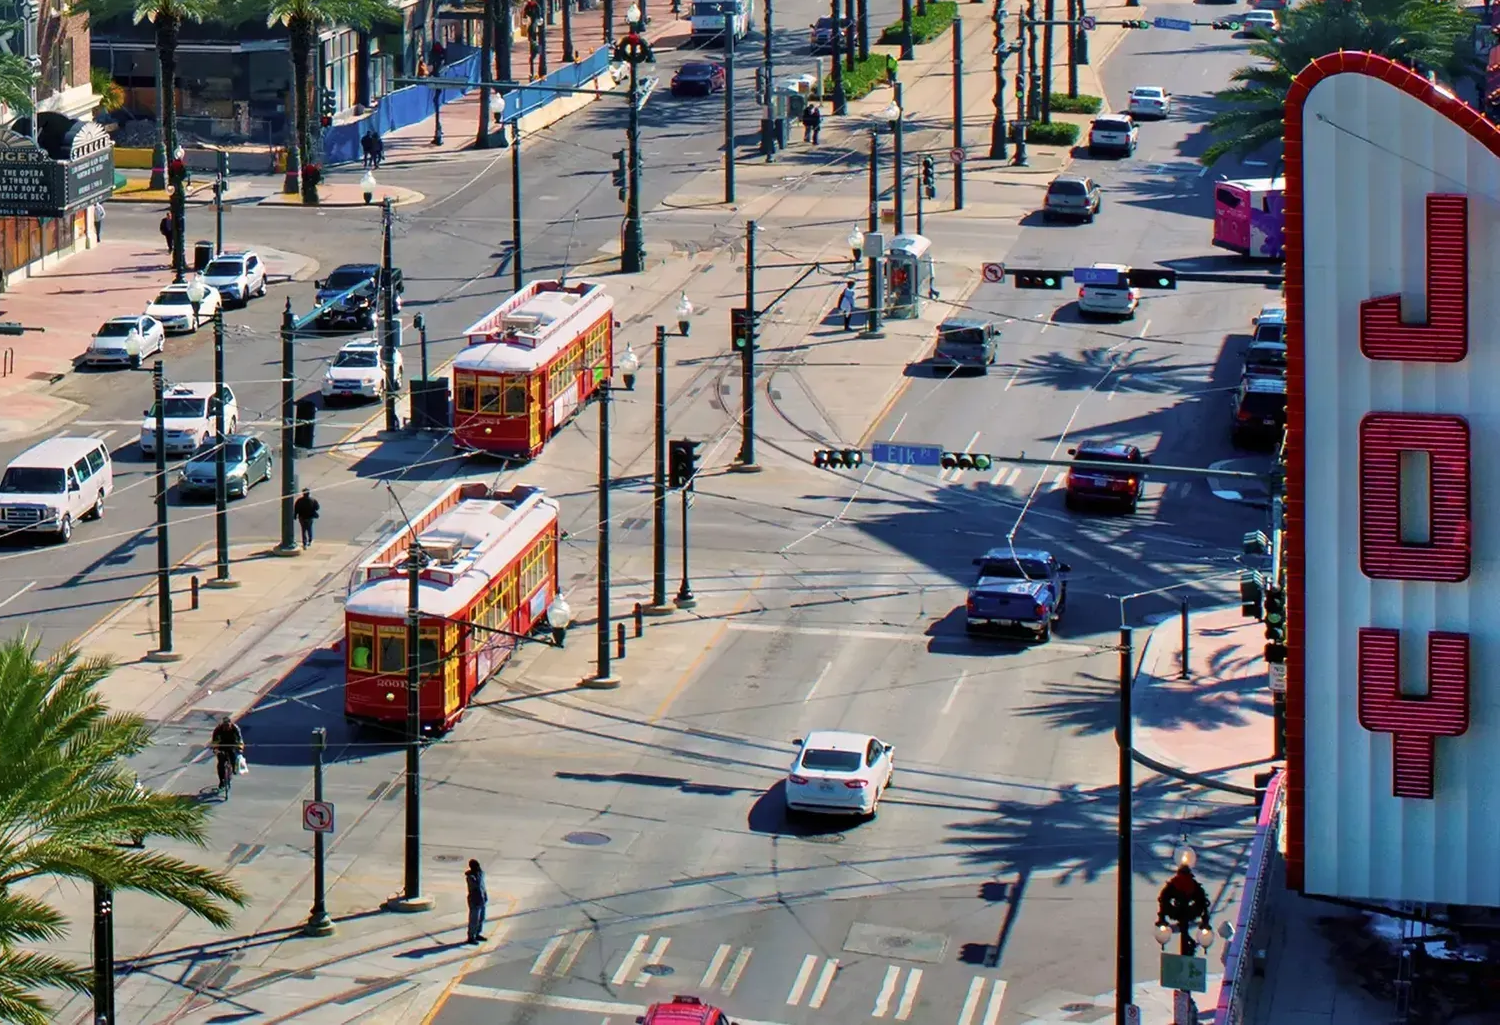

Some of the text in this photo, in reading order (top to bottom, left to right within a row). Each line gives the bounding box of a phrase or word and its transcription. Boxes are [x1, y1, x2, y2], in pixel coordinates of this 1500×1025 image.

[4, 169, 17, 177] THE
[20, 169, 44, 177] OPERA
[888, 446, 915, 463] Elk
[1358, 193, 1471, 800] JOY
